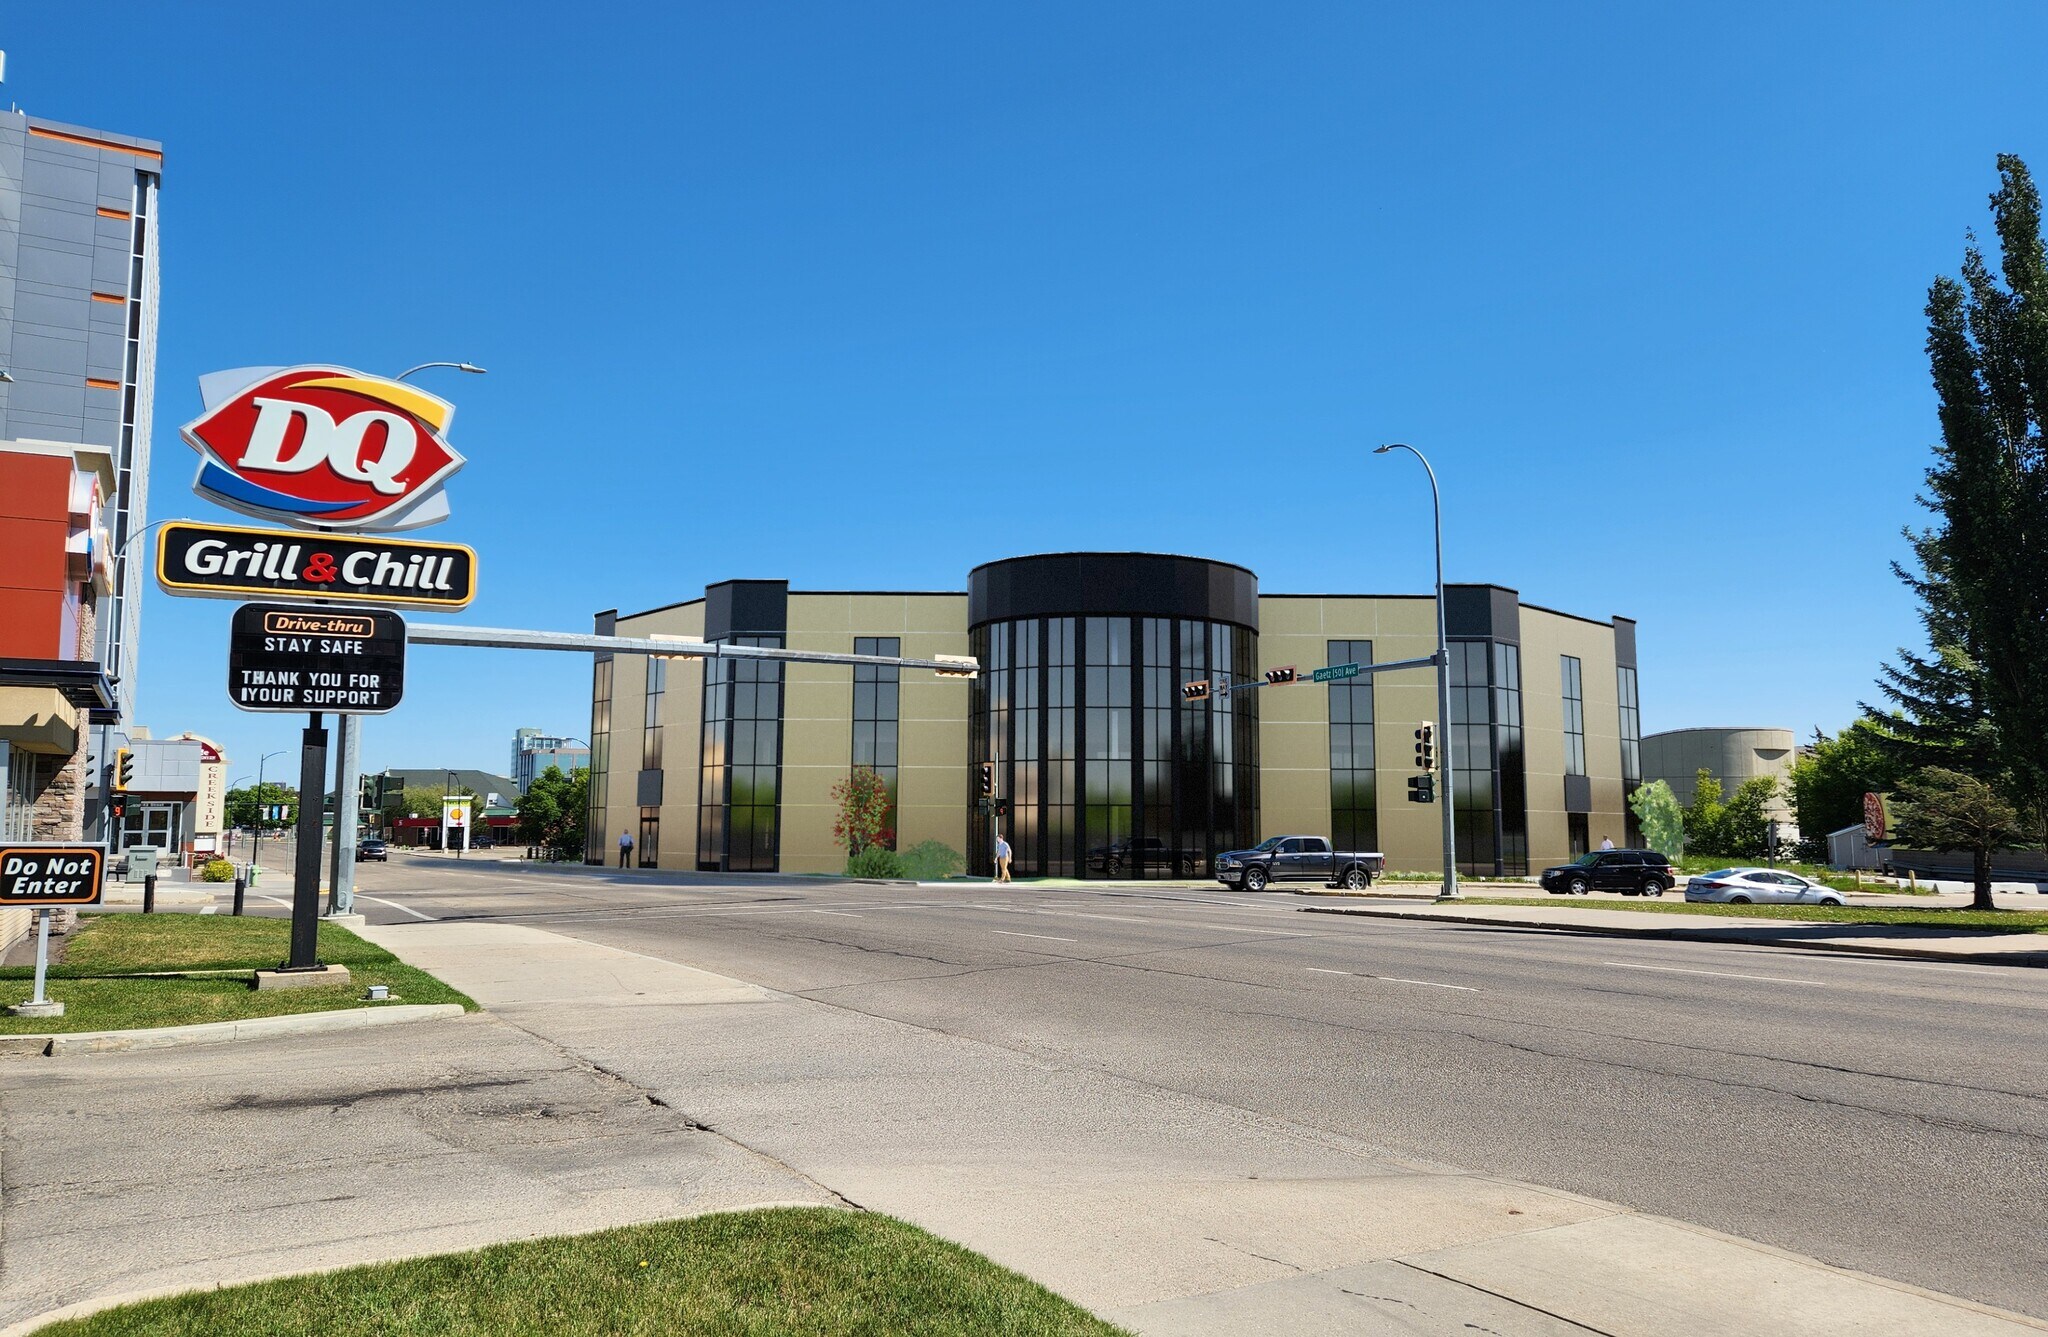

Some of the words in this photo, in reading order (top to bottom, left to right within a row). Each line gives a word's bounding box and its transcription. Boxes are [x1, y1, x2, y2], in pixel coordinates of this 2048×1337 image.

[237, 396, 417, 494] DQ
[184, 540, 301, 581] Grill
[302, 553, 338, 582] &
[342, 551, 453, 590] Chill
[275, 616, 364, 633] Drive-thru
[264, 637, 312, 652] STAY
[320, 639, 363, 655] SAFE
[241, 670, 299, 686] THANK
[309, 672, 341, 687] YOU
[350, 674, 380, 689] FOR
[1315, 671, 1331, 680] Gaetz
[1345, 667, 1356, 675] Ave
[303, 689, 380, 705] SUPPORT
[205, 766, 218, 828] CREEKSIDE
[4, 857, 38, 876] Do
[45, 857, 92, 876] Not
[11, 876, 82, 894] Enter
